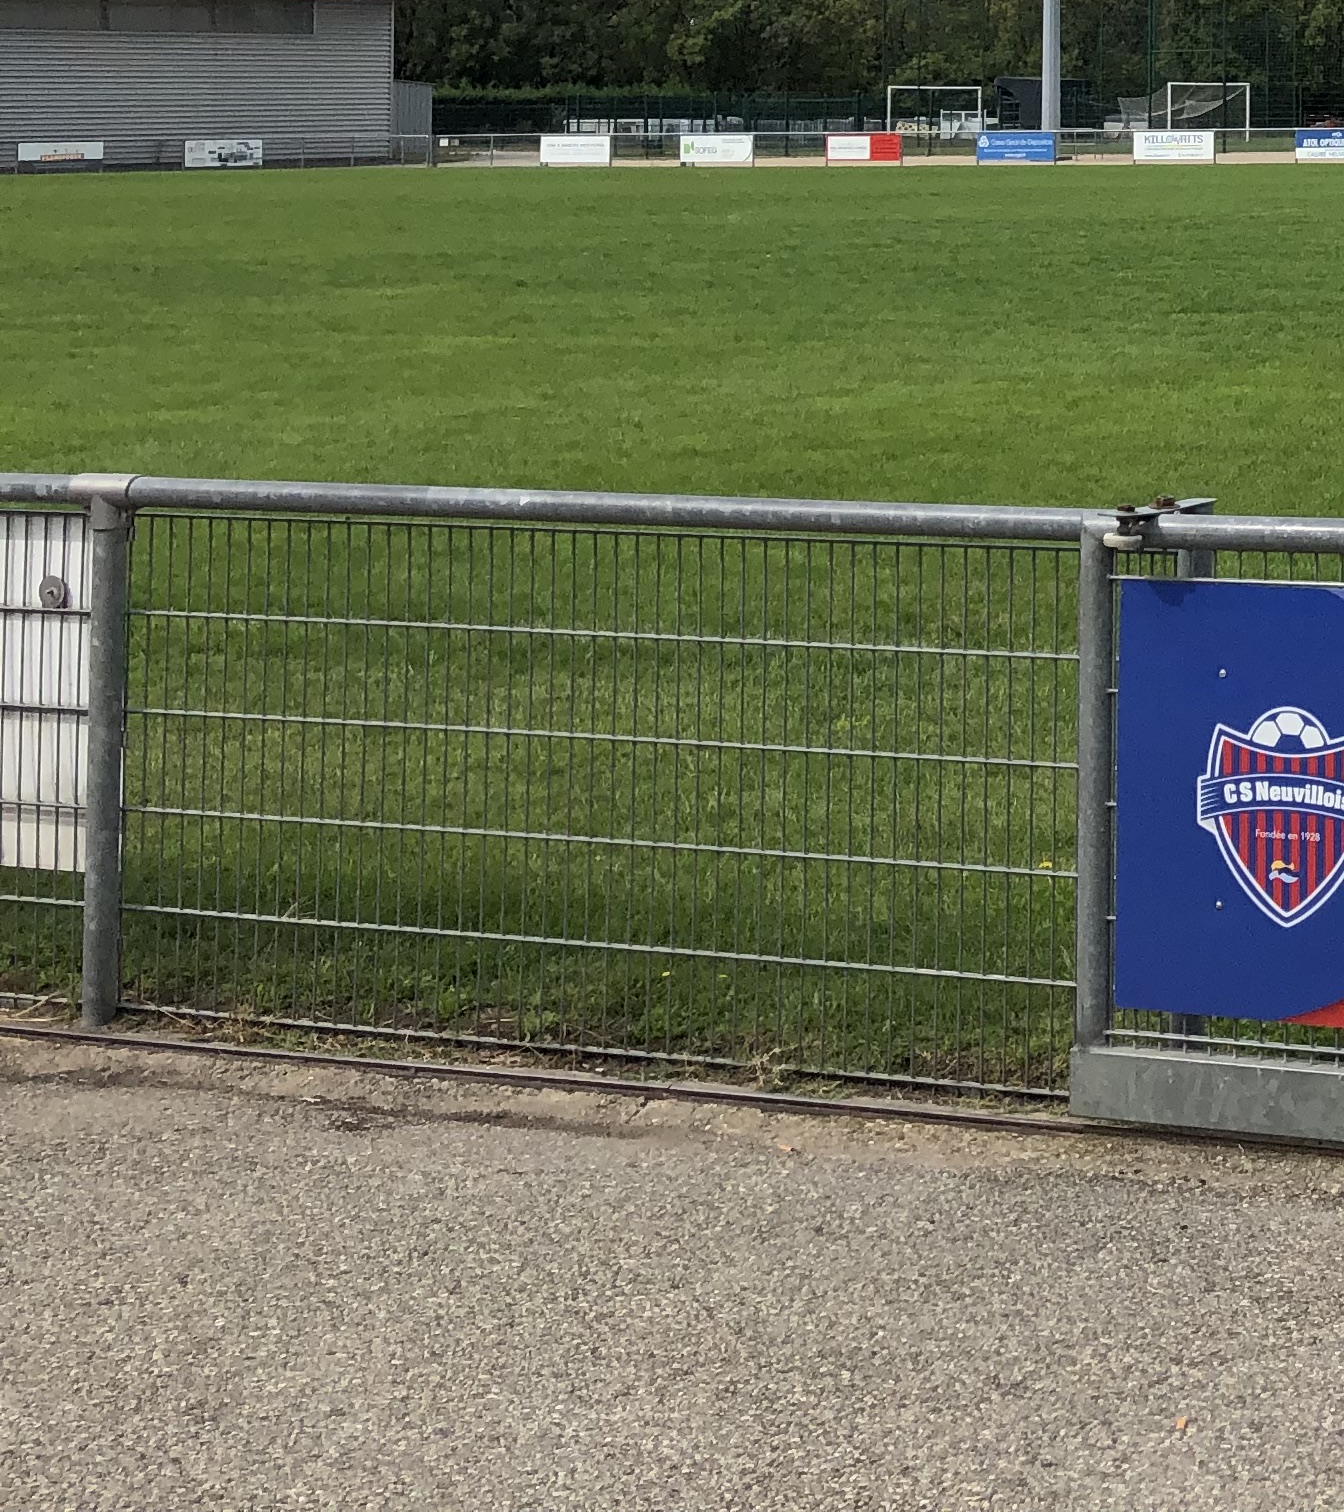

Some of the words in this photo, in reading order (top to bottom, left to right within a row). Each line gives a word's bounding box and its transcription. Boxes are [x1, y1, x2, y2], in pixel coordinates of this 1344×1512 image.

[1144, 134, 1204, 145] KILLOWATTS
[1255, 829, 1286, 841] Fondée
[1287, 833, 1299, 841] en
[1300, 832, 1321, 842] 1928
